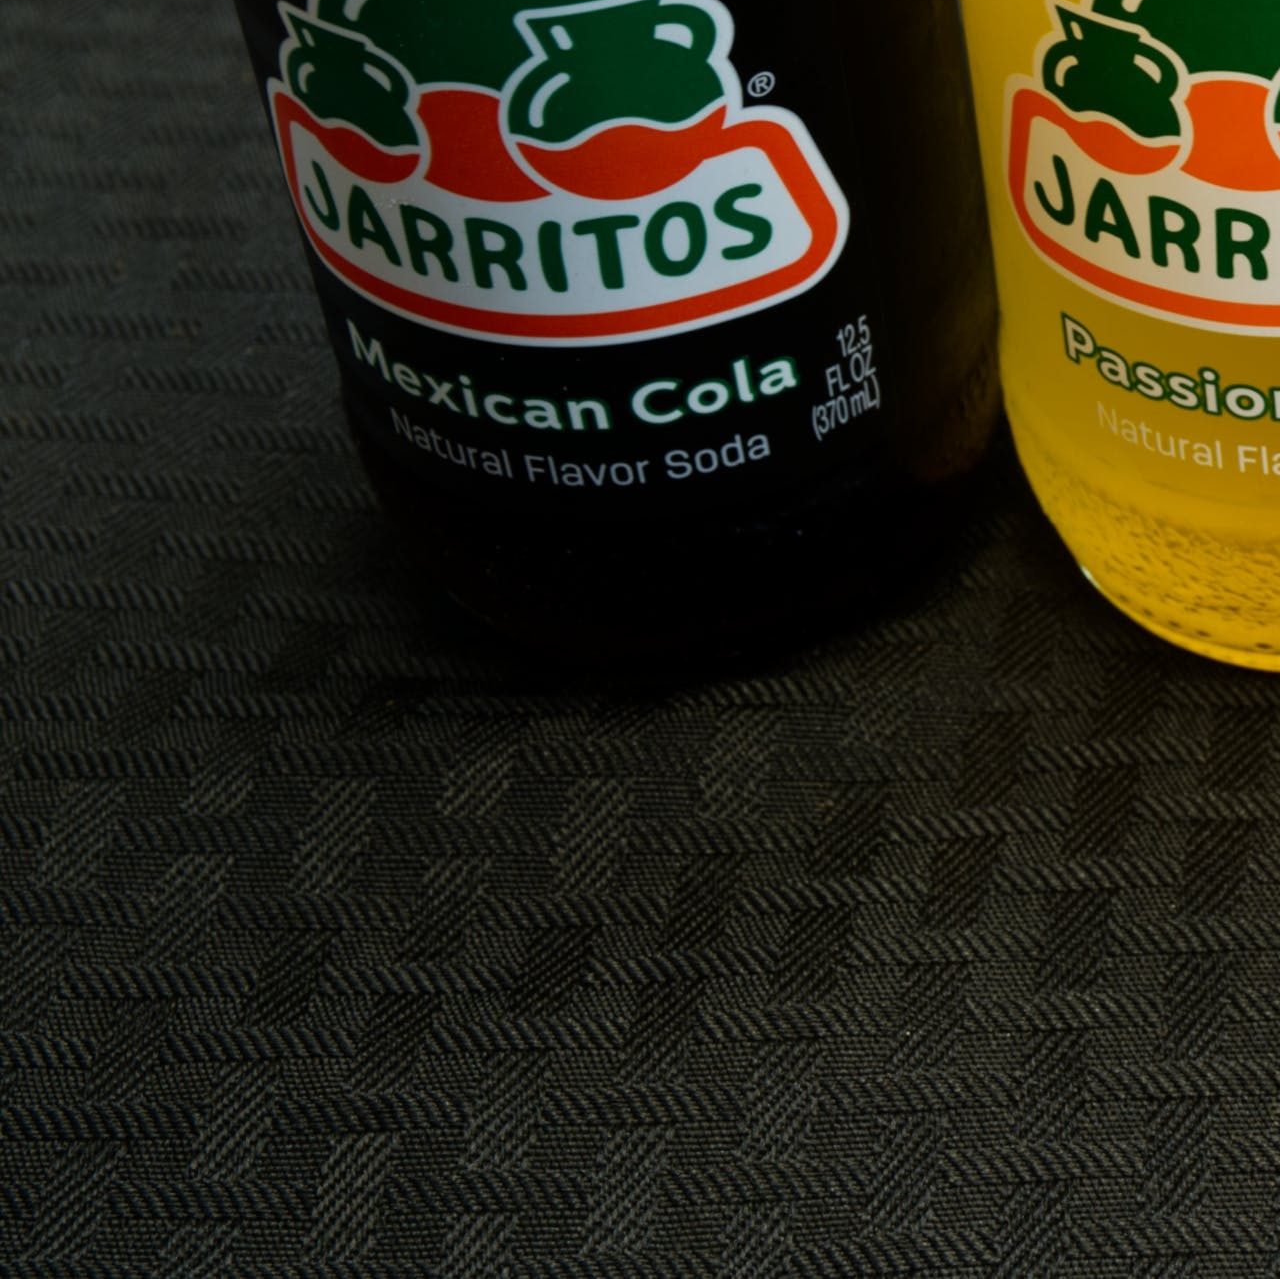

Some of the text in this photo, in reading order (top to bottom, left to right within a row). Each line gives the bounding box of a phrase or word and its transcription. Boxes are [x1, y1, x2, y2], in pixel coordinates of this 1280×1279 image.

[303, 159, 773, 294] JARRITOS
[825, 344, 877, 398] FL OZ
[836, 314, 871, 358] 12.5
[345, 316, 799, 431] Mexican Cola
[388, 406, 771, 487] Natural Flavor Soda
[811, 394, 850, 441] (370
[1096, 400, 1224, 470] Natural
